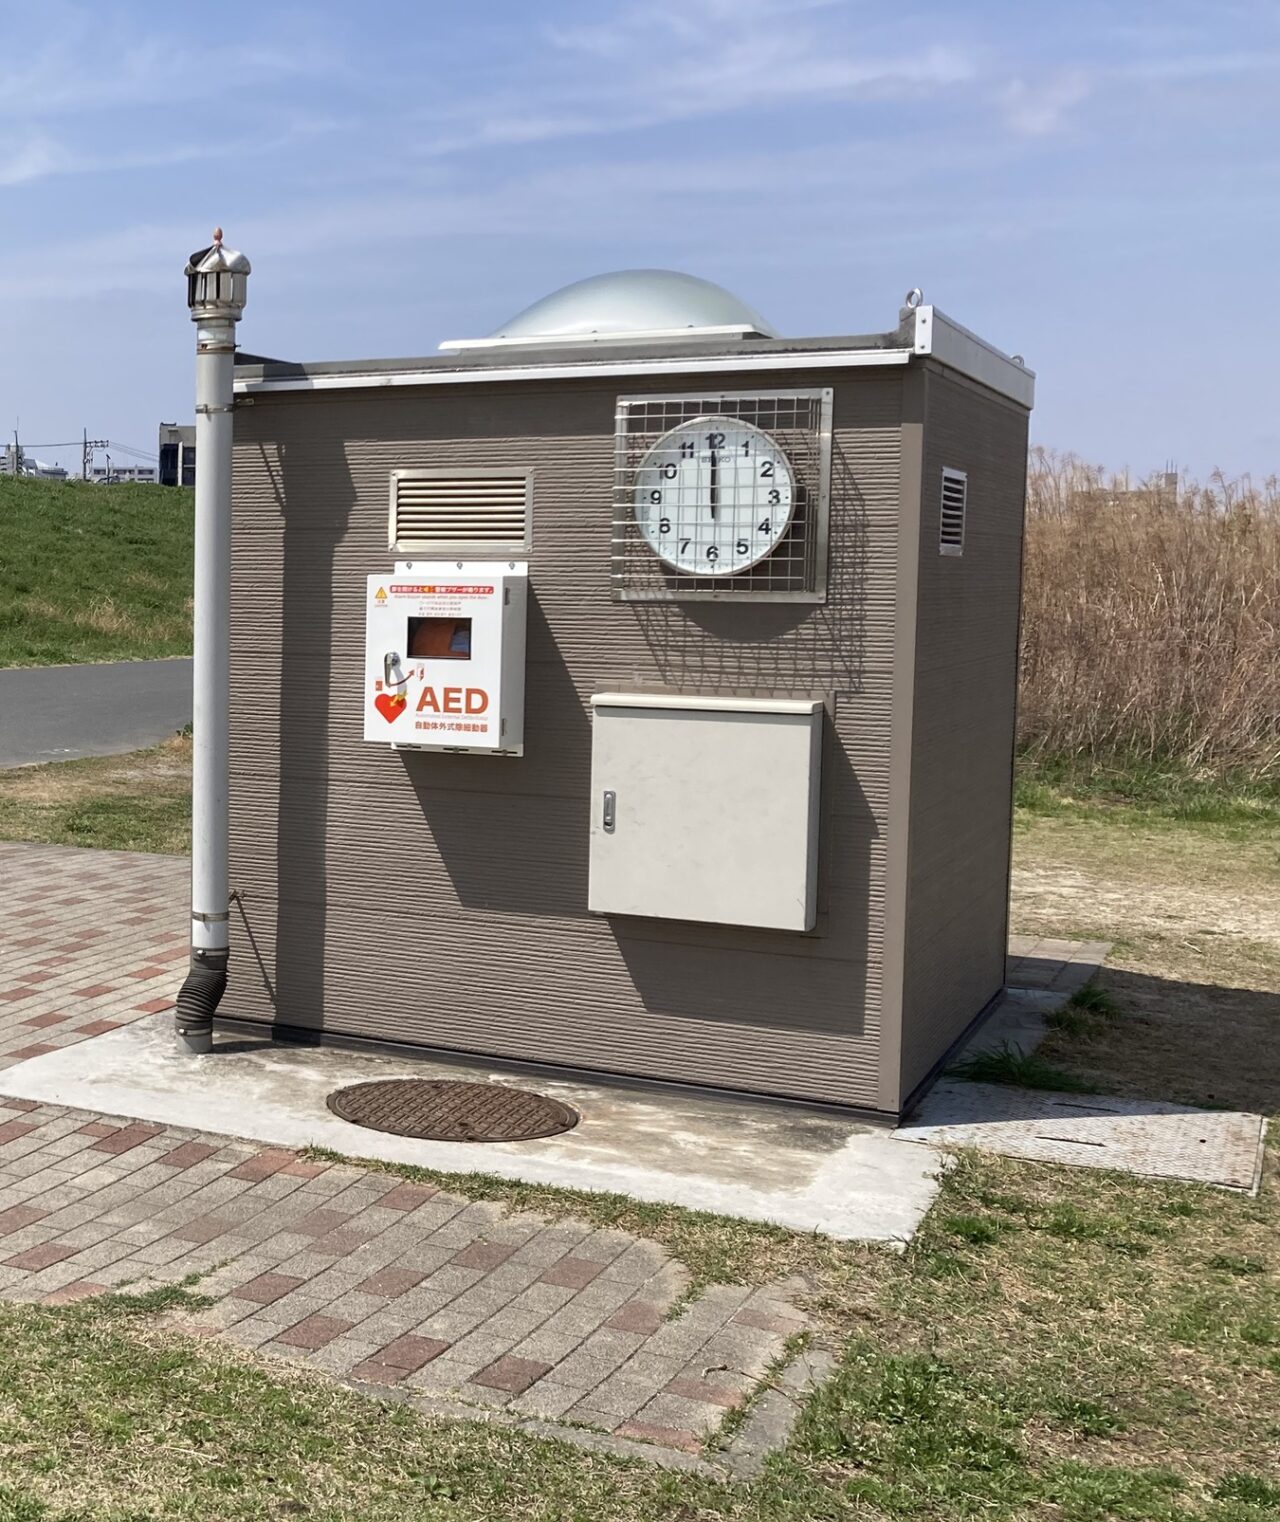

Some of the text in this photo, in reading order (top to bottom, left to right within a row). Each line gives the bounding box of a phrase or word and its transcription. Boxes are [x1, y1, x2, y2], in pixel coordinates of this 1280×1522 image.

[705, 433, 726, 449] 12
[741, 441, 749, 457] 1
[679, 442, 694, 458] 11
[657, 463, 678, 480] 10
[760, 461, 774, 478] 2
[650, 490, 662, 505] 9
[768, 489, 781, 506] 3
[659, 518, 671, 533] 8
[758, 518, 772, 535] 4
[679, 538, 691, 554] 7
[706, 545, 719, 562] 6
[736, 538, 749, 554] 5
[416, 686, 489, 714] AED
[415, 721, 488, 733] 自動体外式除細動器
